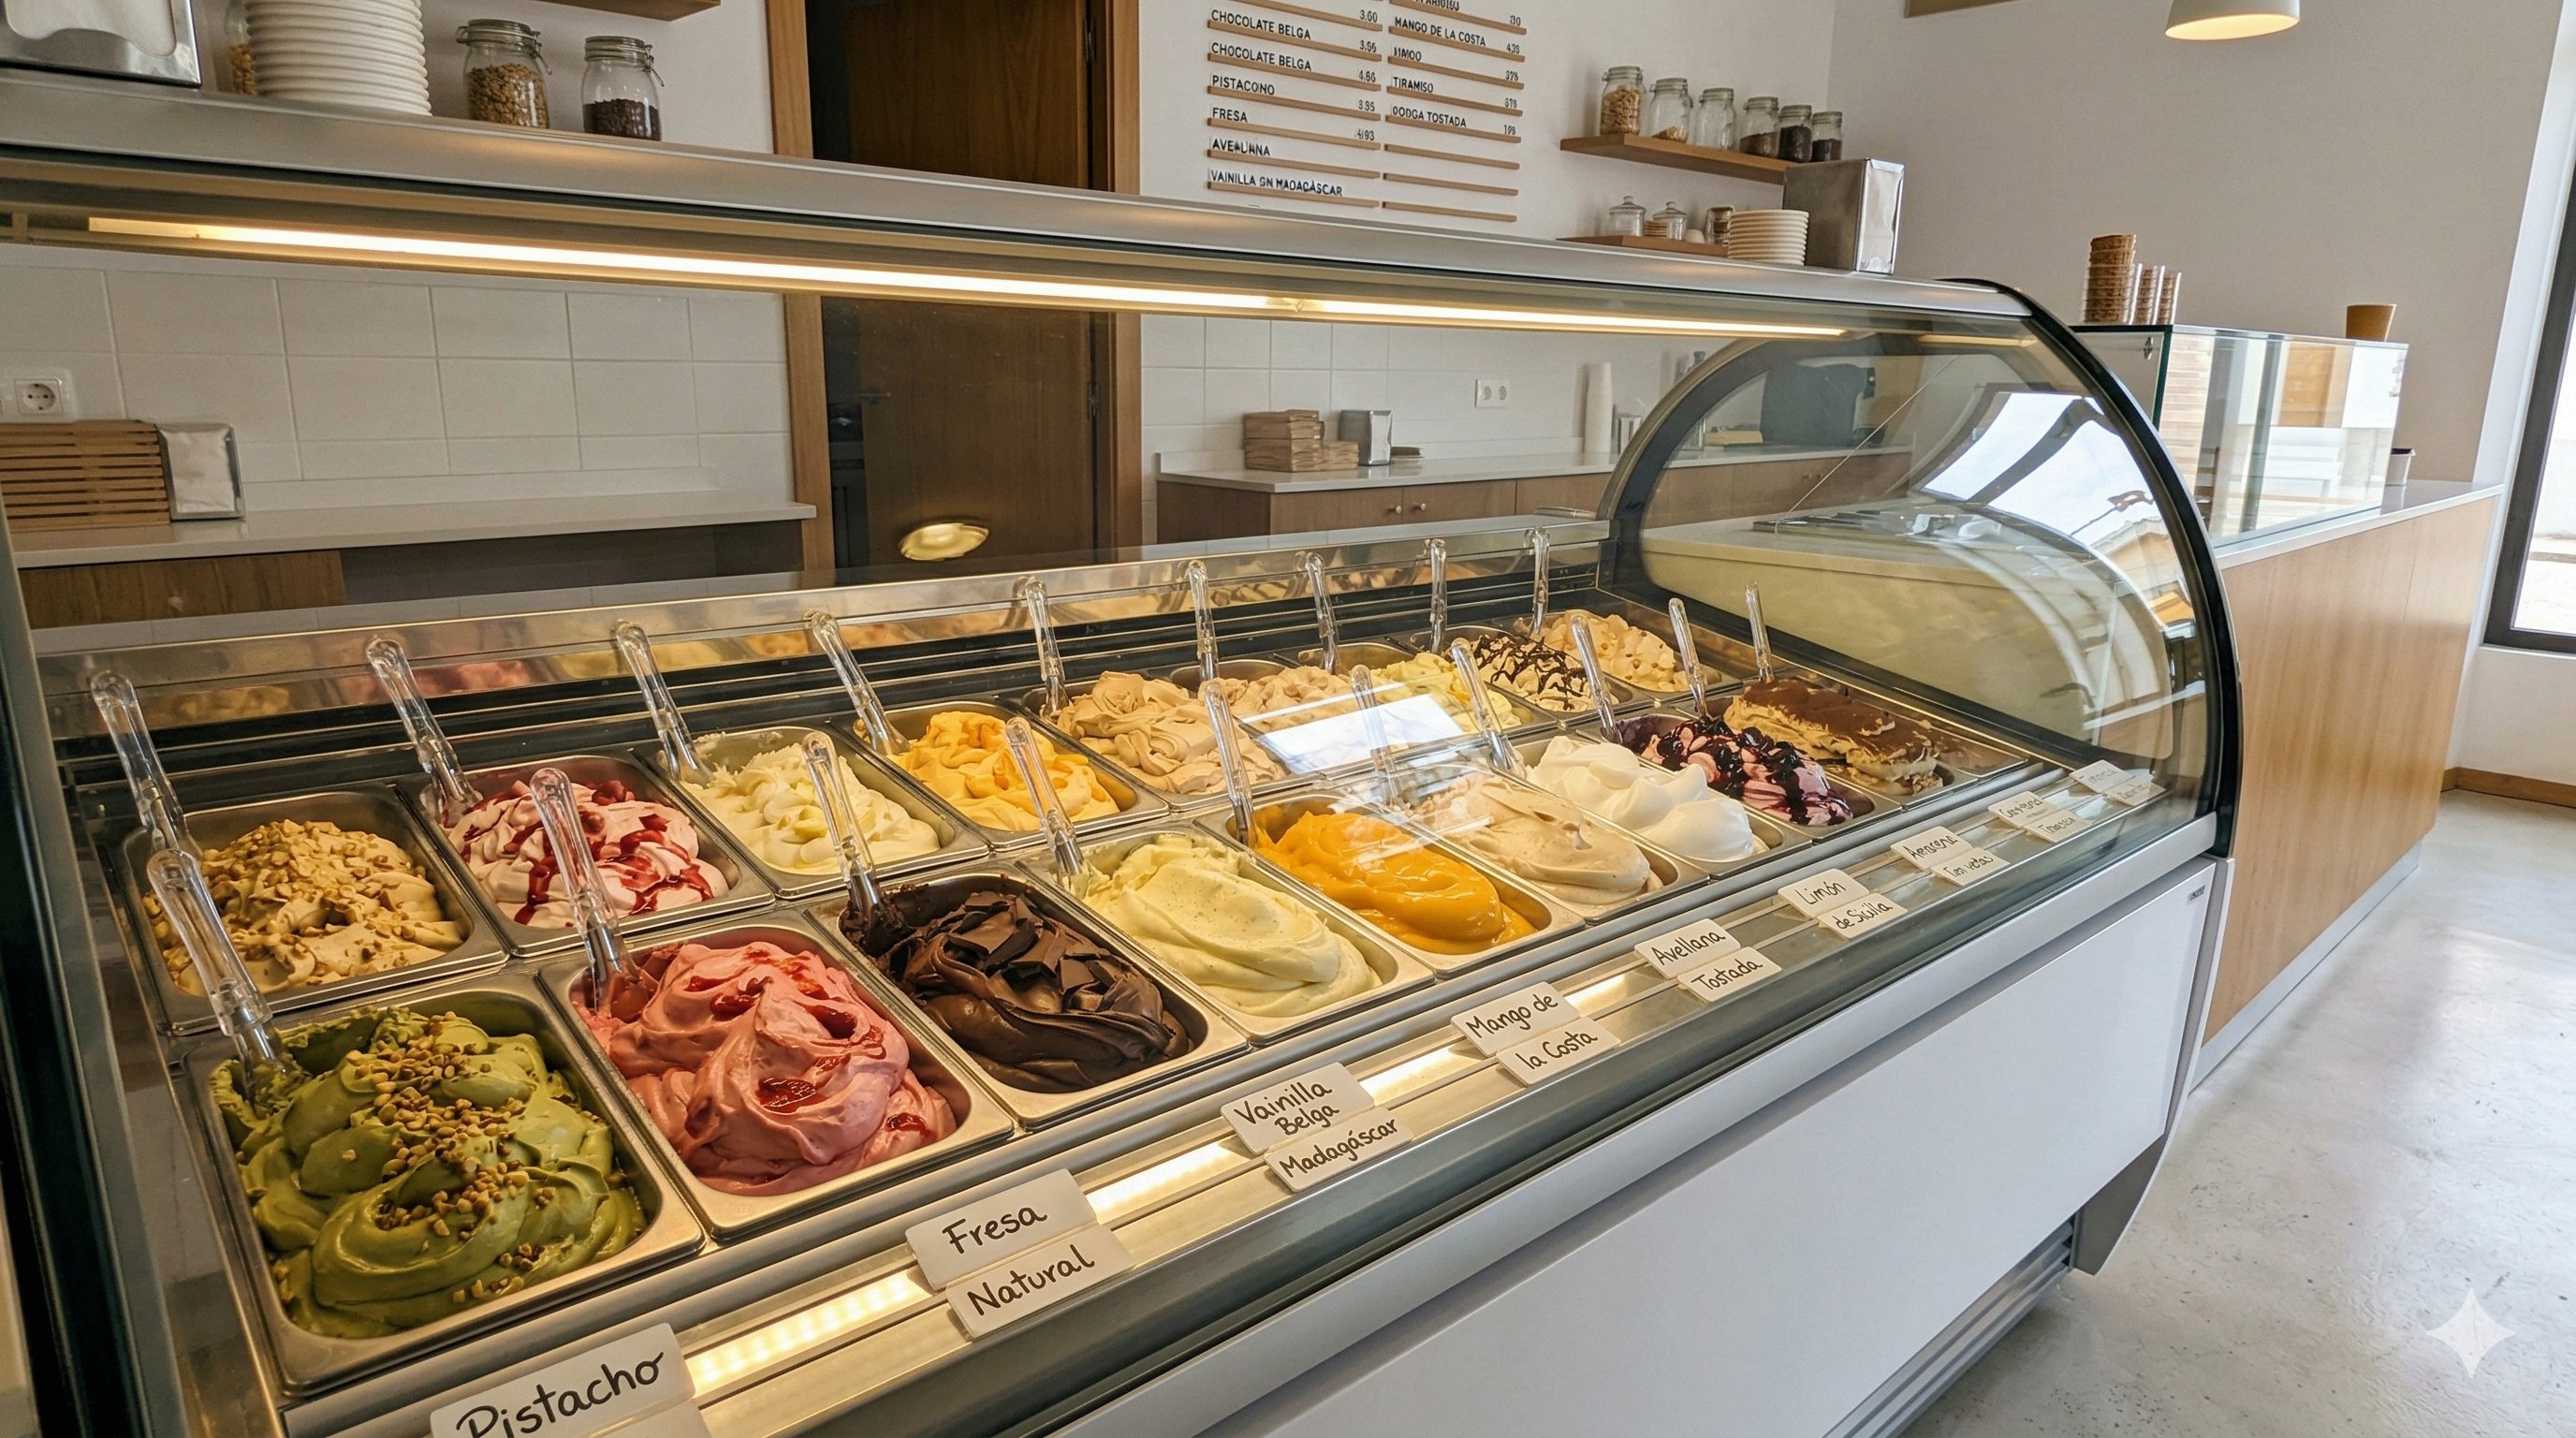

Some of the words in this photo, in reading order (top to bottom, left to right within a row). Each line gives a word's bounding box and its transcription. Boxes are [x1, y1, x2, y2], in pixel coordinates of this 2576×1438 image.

[1211, 9, 1275, 33] CHOCOLATE
[1278, 23, 1311, 40] BELGA
[1395, 16, 1427, 34] MANGO
[1430, 24, 1442, 37] DE
[1444, 28, 1456, 40] LA
[1458, 31, 1486, 47] COSTA
[1211, 42, 1275, 65] CHOCOLATE
[1279, 54, 1312, 71] BELGA
[1212, 75, 1275, 95] PISTACONO
[1212, 107, 1249, 124] FRESA
[1426, 110, 1467, 128] TOSTADA
[1210, 169, 1257, 186] VAINILLA
[1793, 881, 1847, 905] Limón
[1832, 915, 1855, 930] de
[1650, 927, 1726, 966] Avellana
[1690, 955, 1764, 990] Tostada
[1465, 1004, 1532, 1039] Mango
[1533, 992, 1559, 1012] de
[1515, 1051, 1547, 1071] la
[1543, 1027, 1598, 1061] Costa
[1233, 1079, 1333, 1126] Vainilla
[1274, 1103, 1340, 1137] Belga
[1278, 1118, 1399, 1179] Madagáscar
[942, 1204, 1048, 1255] Fresa
[966, 1244, 1096, 1316] Natural
[456, 1351, 665, 1438] Pistacho
